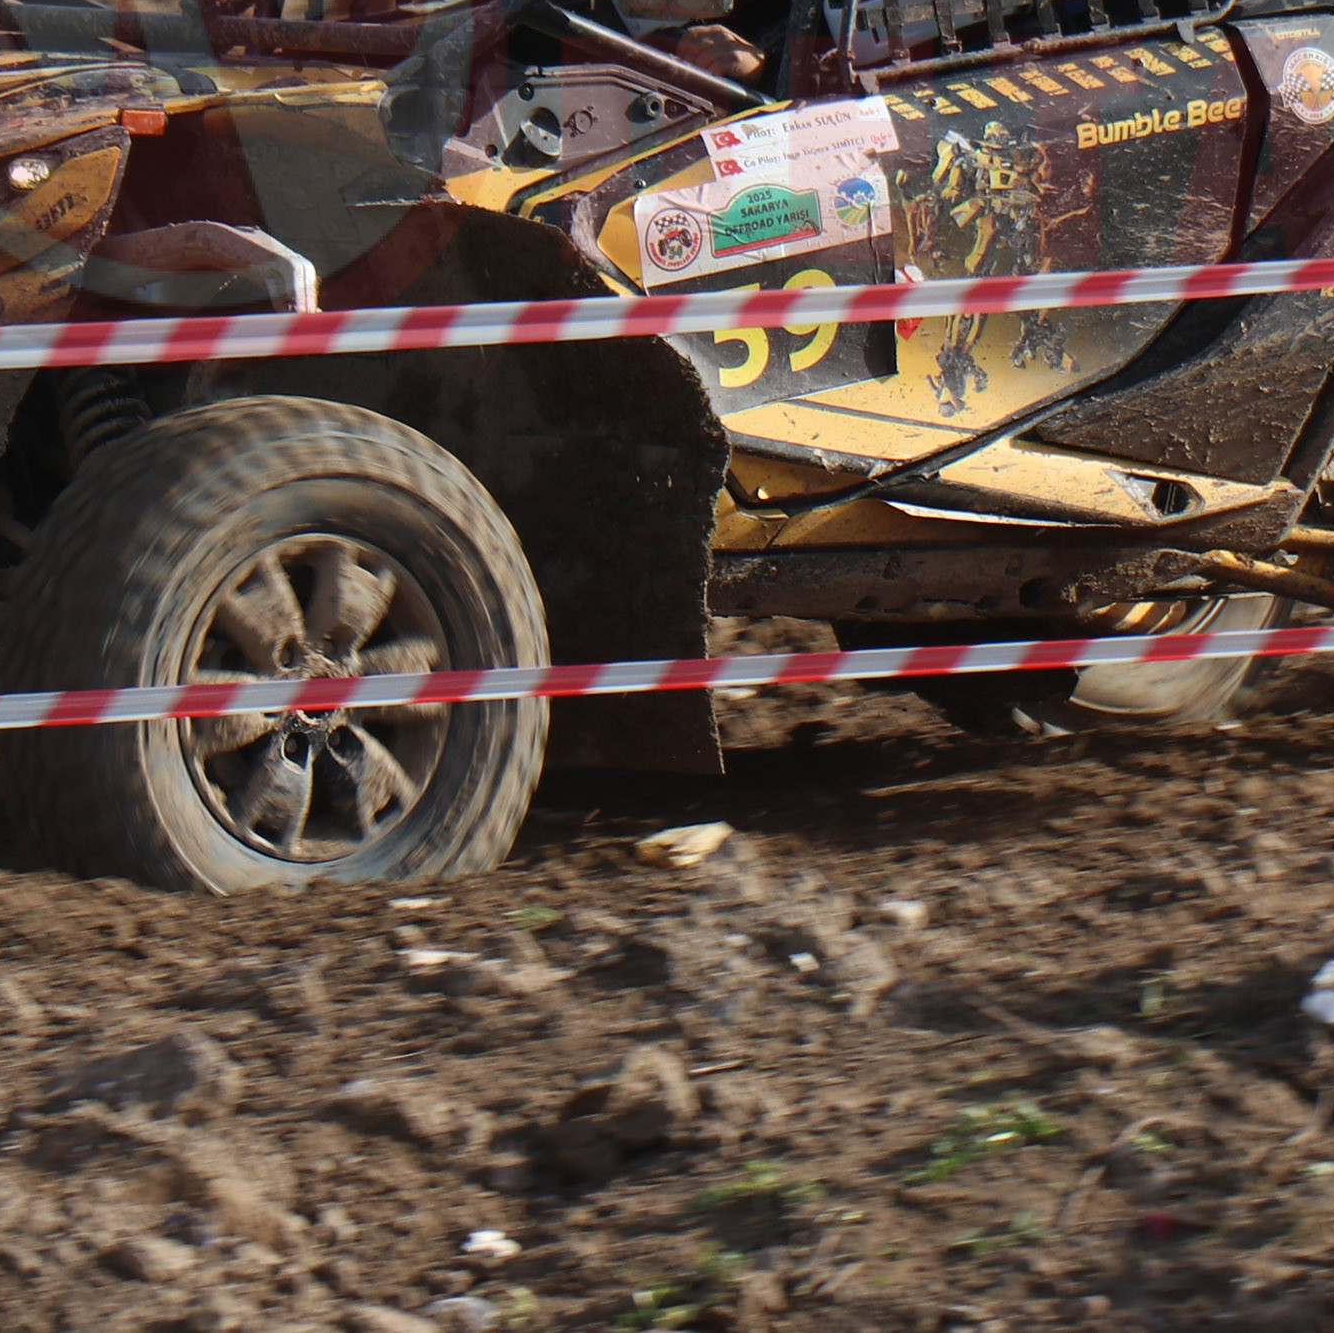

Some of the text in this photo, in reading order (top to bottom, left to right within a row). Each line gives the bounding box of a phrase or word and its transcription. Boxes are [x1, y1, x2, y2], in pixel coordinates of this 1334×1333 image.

[1076, 97, 1248, 150] Bumble Bee
[747, 190, 772, 203] 2025
[740, 199, 789, 218] SAKARYA
[725, 216, 773, 236] OFFROAD
[712, 268, 839, 389] 59
